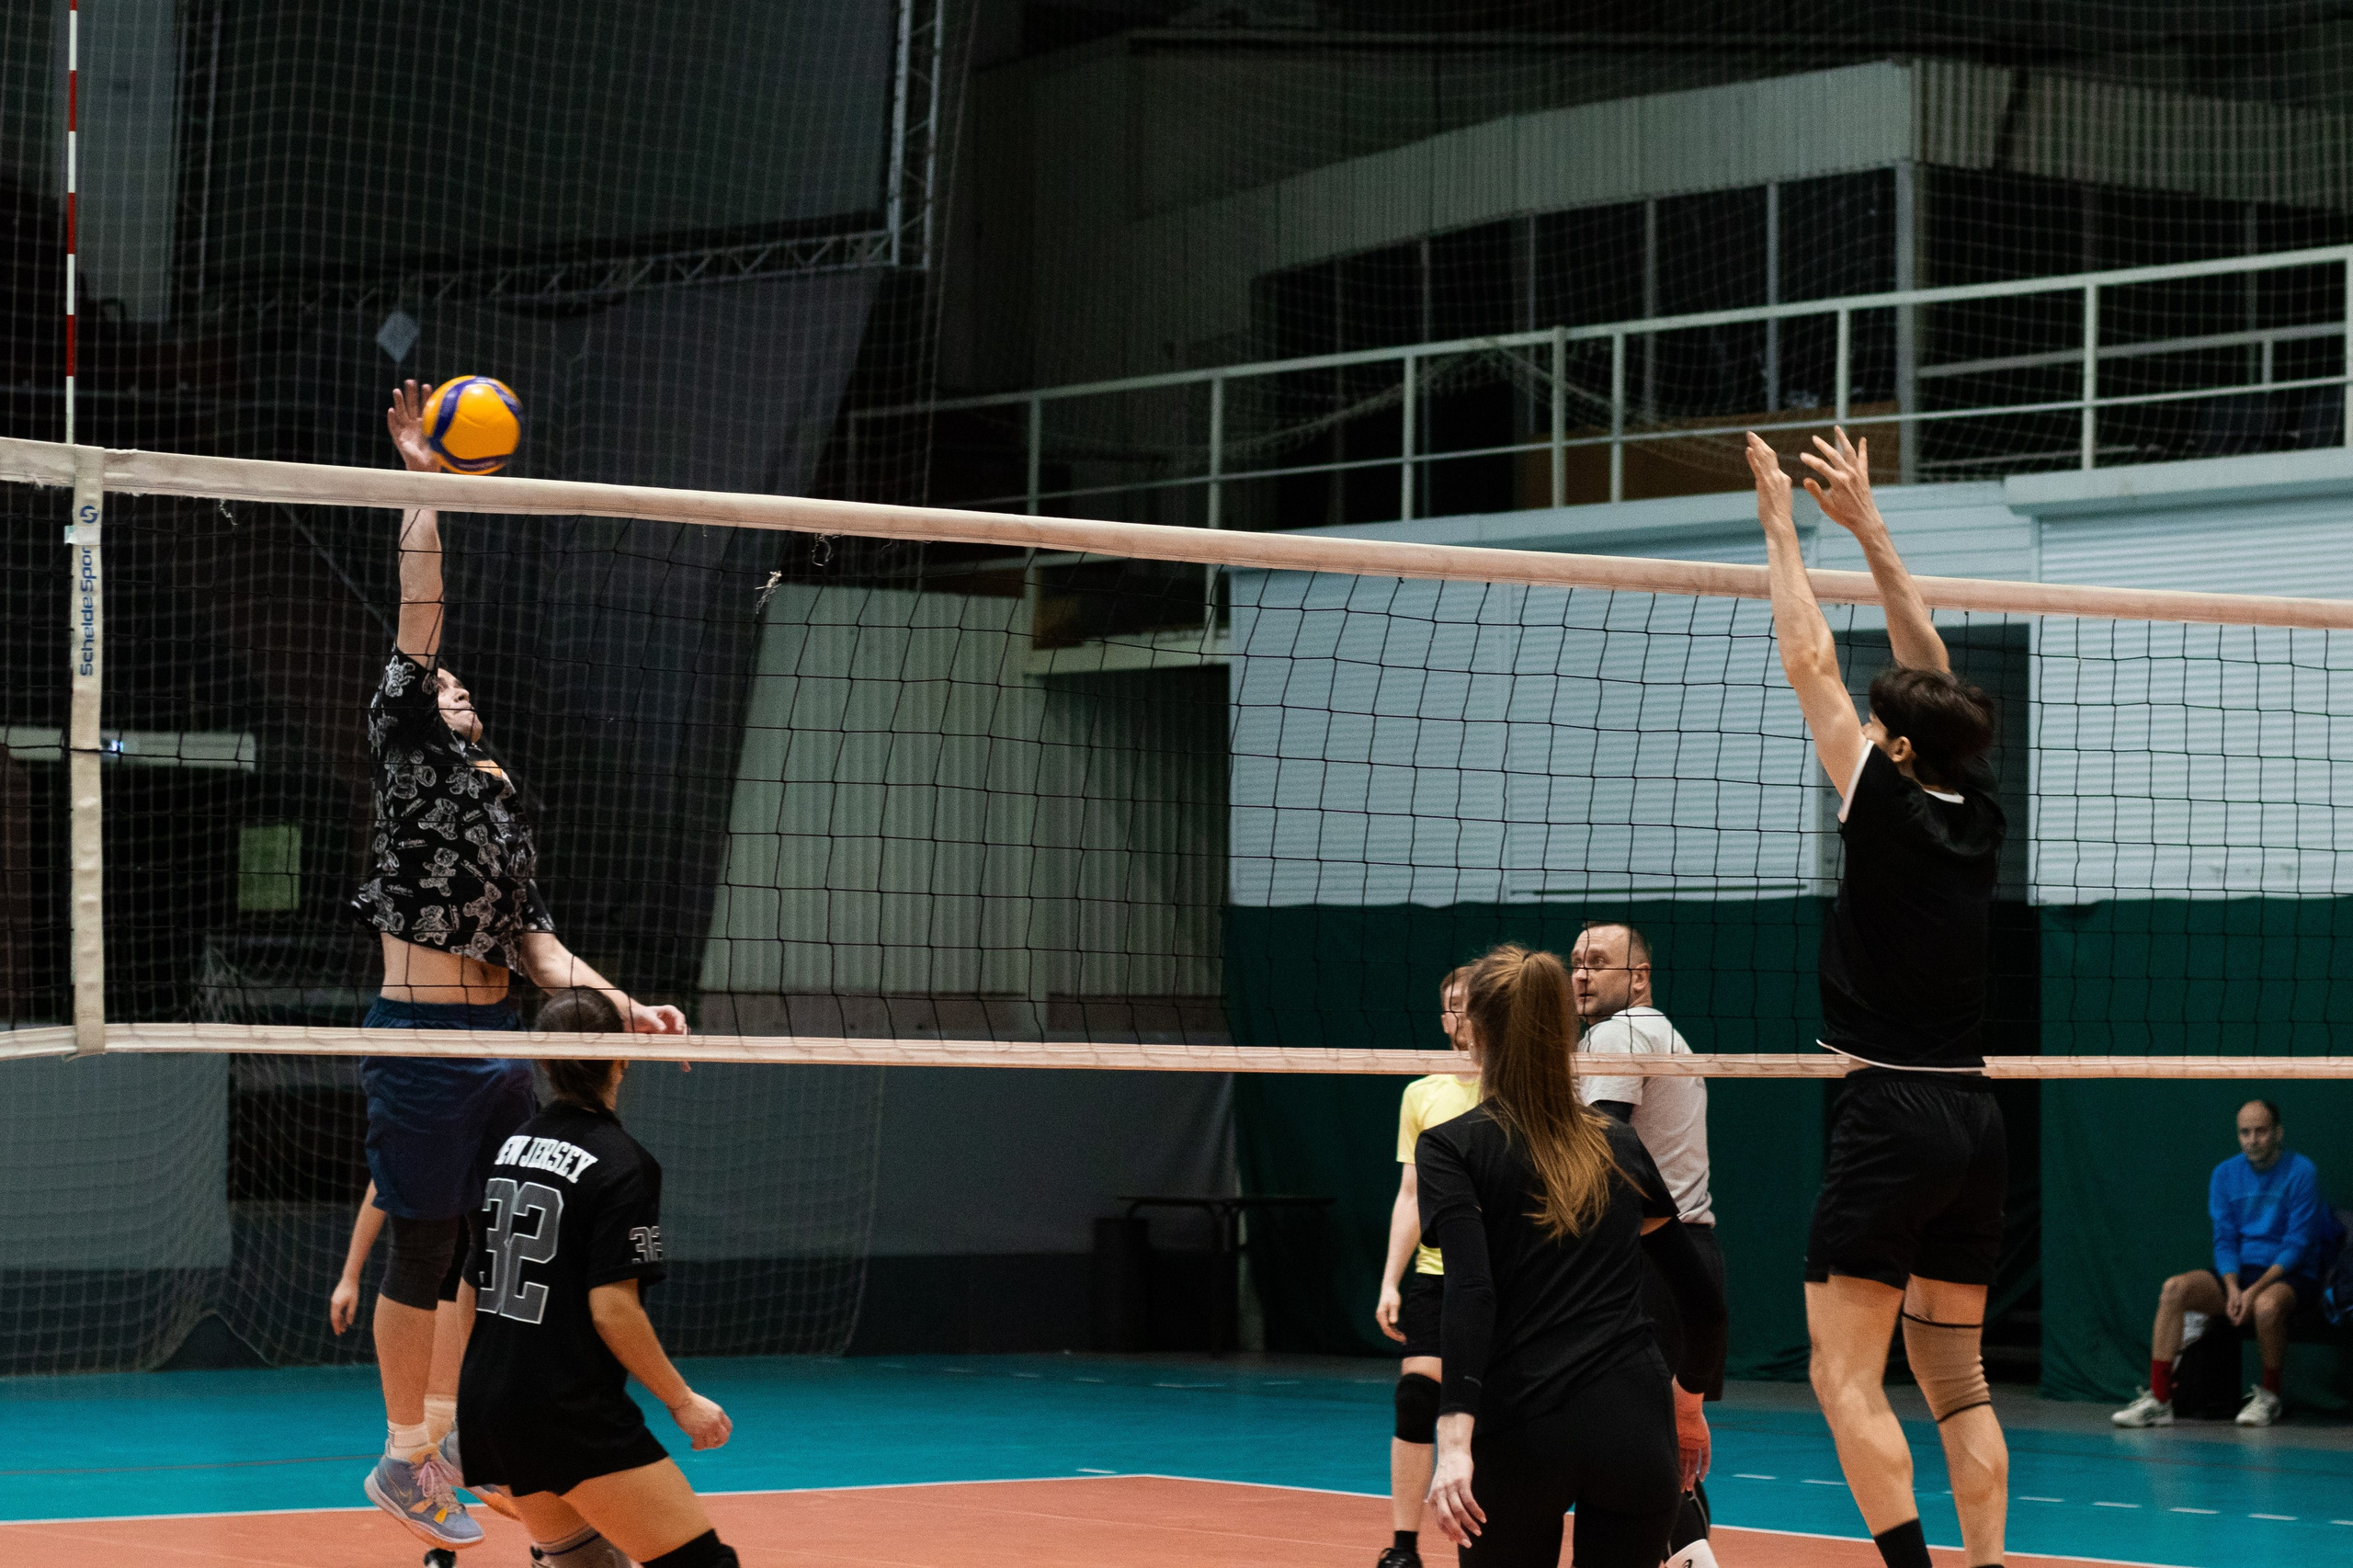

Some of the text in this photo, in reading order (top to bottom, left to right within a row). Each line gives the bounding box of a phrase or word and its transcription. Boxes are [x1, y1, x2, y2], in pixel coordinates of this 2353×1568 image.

[79, 545, 97, 676] Schelde Spor
[518, 1137, 599, 1184] JERSEY
[475, 1176, 564, 1324] 32
